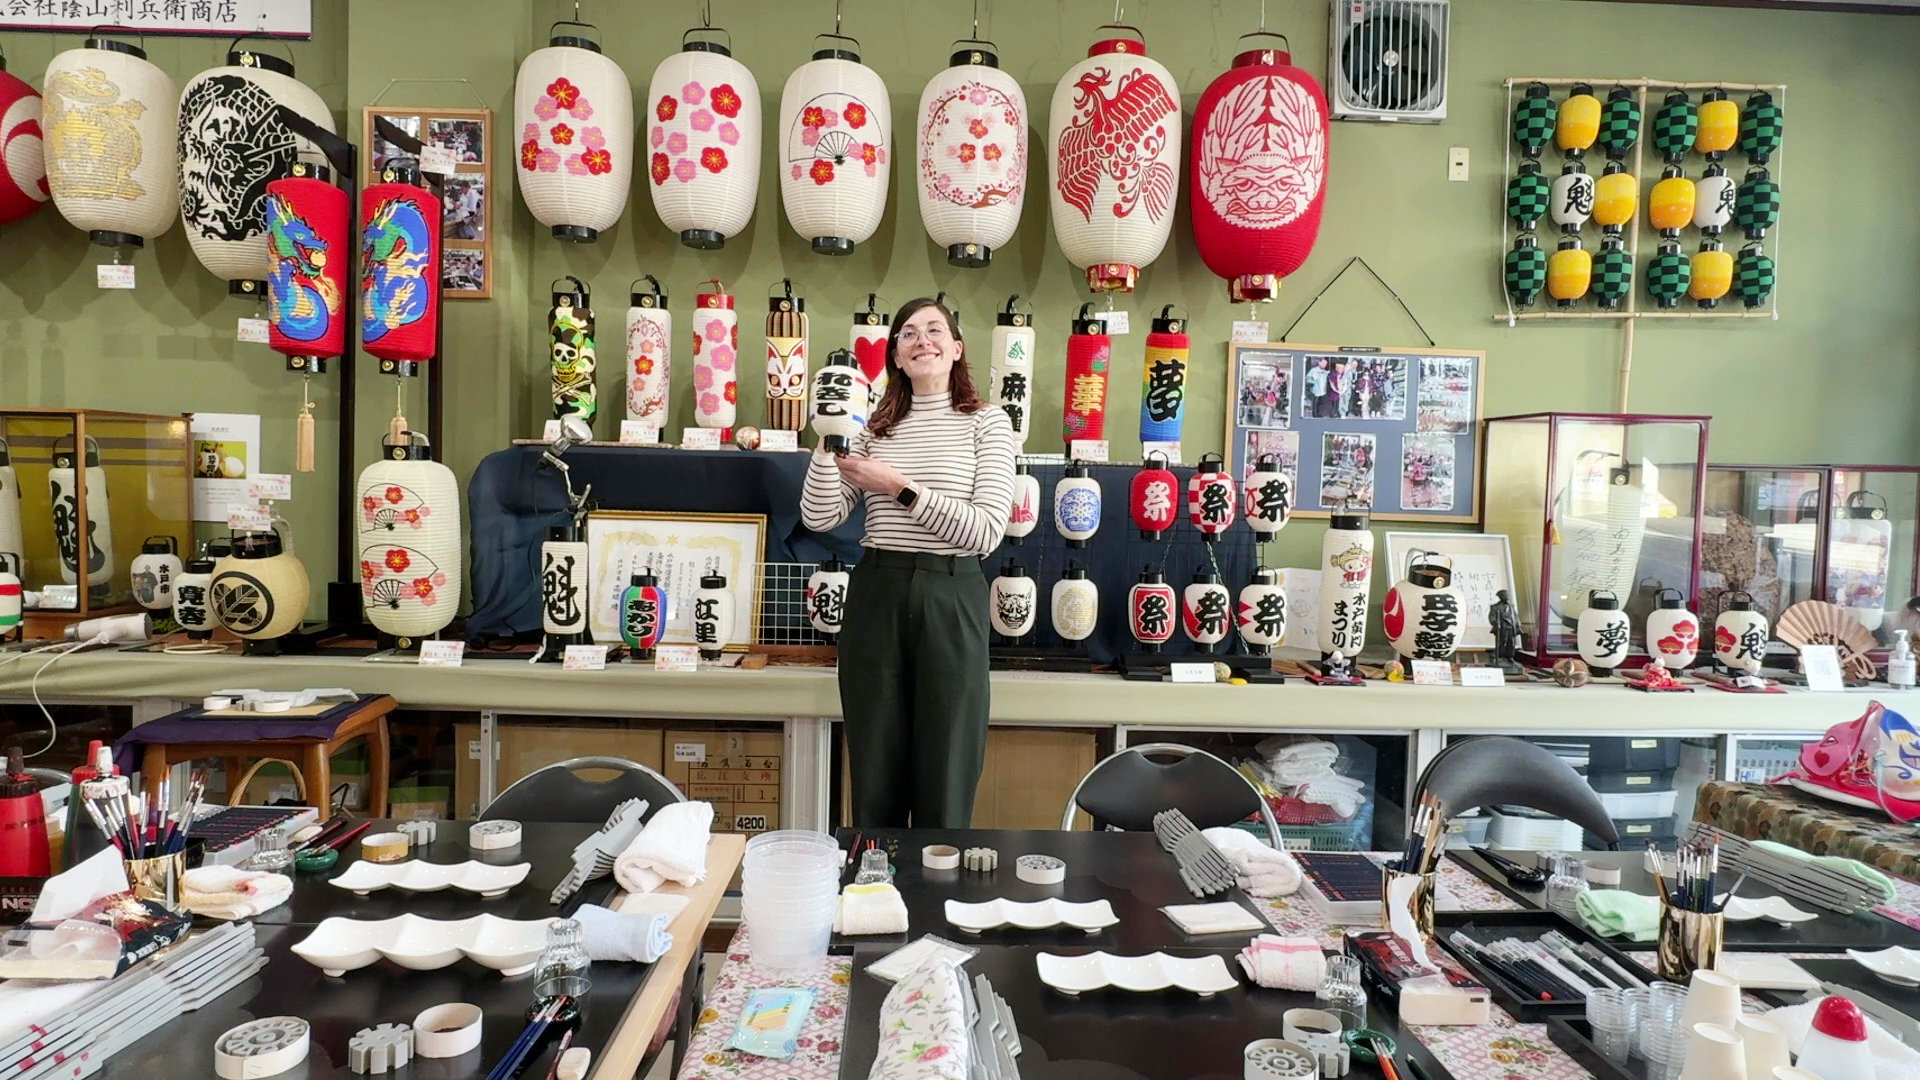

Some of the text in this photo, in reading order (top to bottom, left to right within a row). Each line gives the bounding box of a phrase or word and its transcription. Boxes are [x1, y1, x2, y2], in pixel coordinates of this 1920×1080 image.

[0, 0, 238, 23] 会社陰山利兵衛商店
[1143, 479, 1172, 522] 祭
[1202, 482, 1230, 525] 祭
[1256, 478, 1290, 524] 祭
[1138, 592, 1170, 636] 祭
[1197, 590, 1229, 634] 祭
[1252, 592, 1286, 637] 祭
[1331, 599, 1348, 648] まつり
[737, 816, 765, 830] 4200
